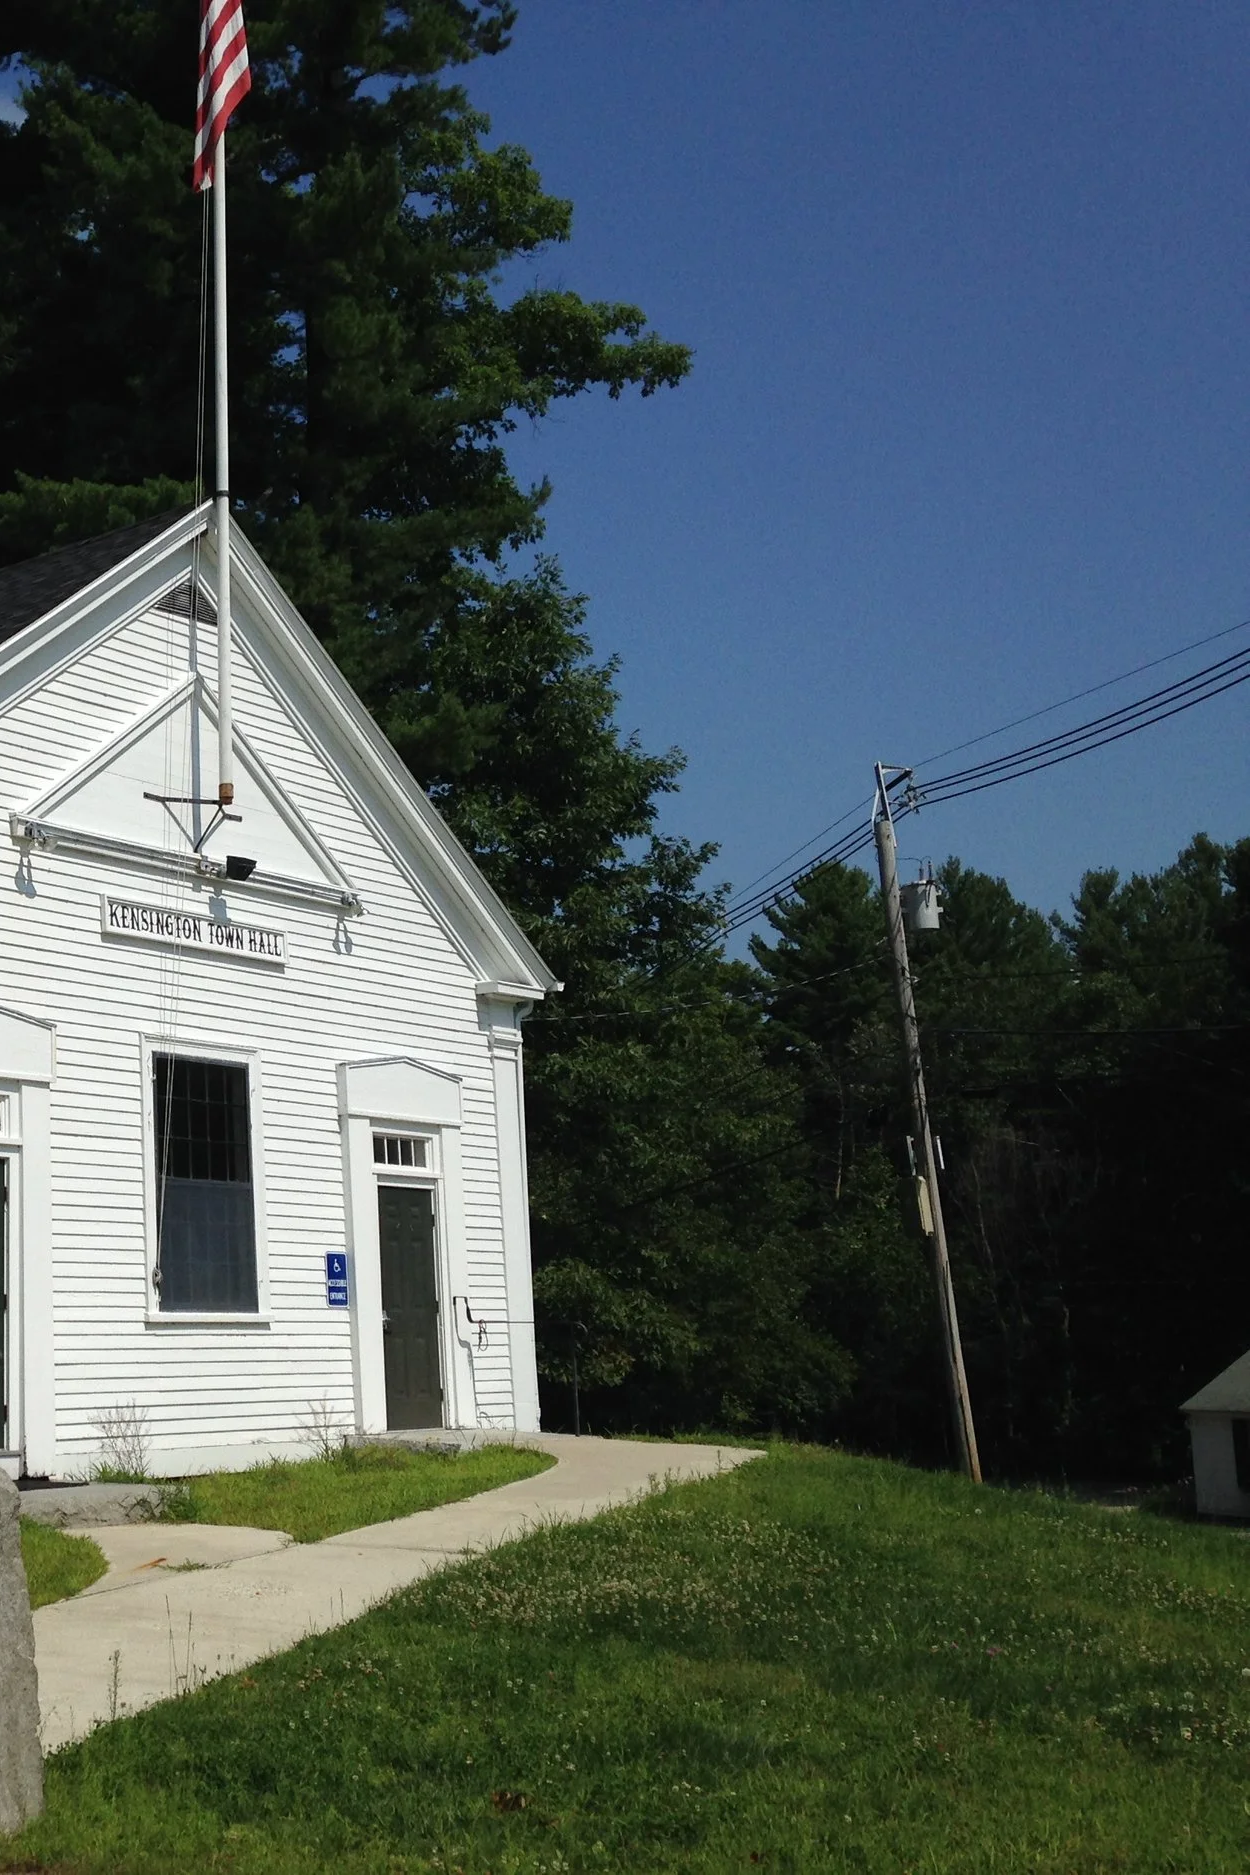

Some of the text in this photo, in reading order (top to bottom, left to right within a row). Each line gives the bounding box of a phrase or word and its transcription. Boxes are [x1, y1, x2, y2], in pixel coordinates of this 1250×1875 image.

[109, 904, 282, 957] KENSINGTON TOWN HALL
